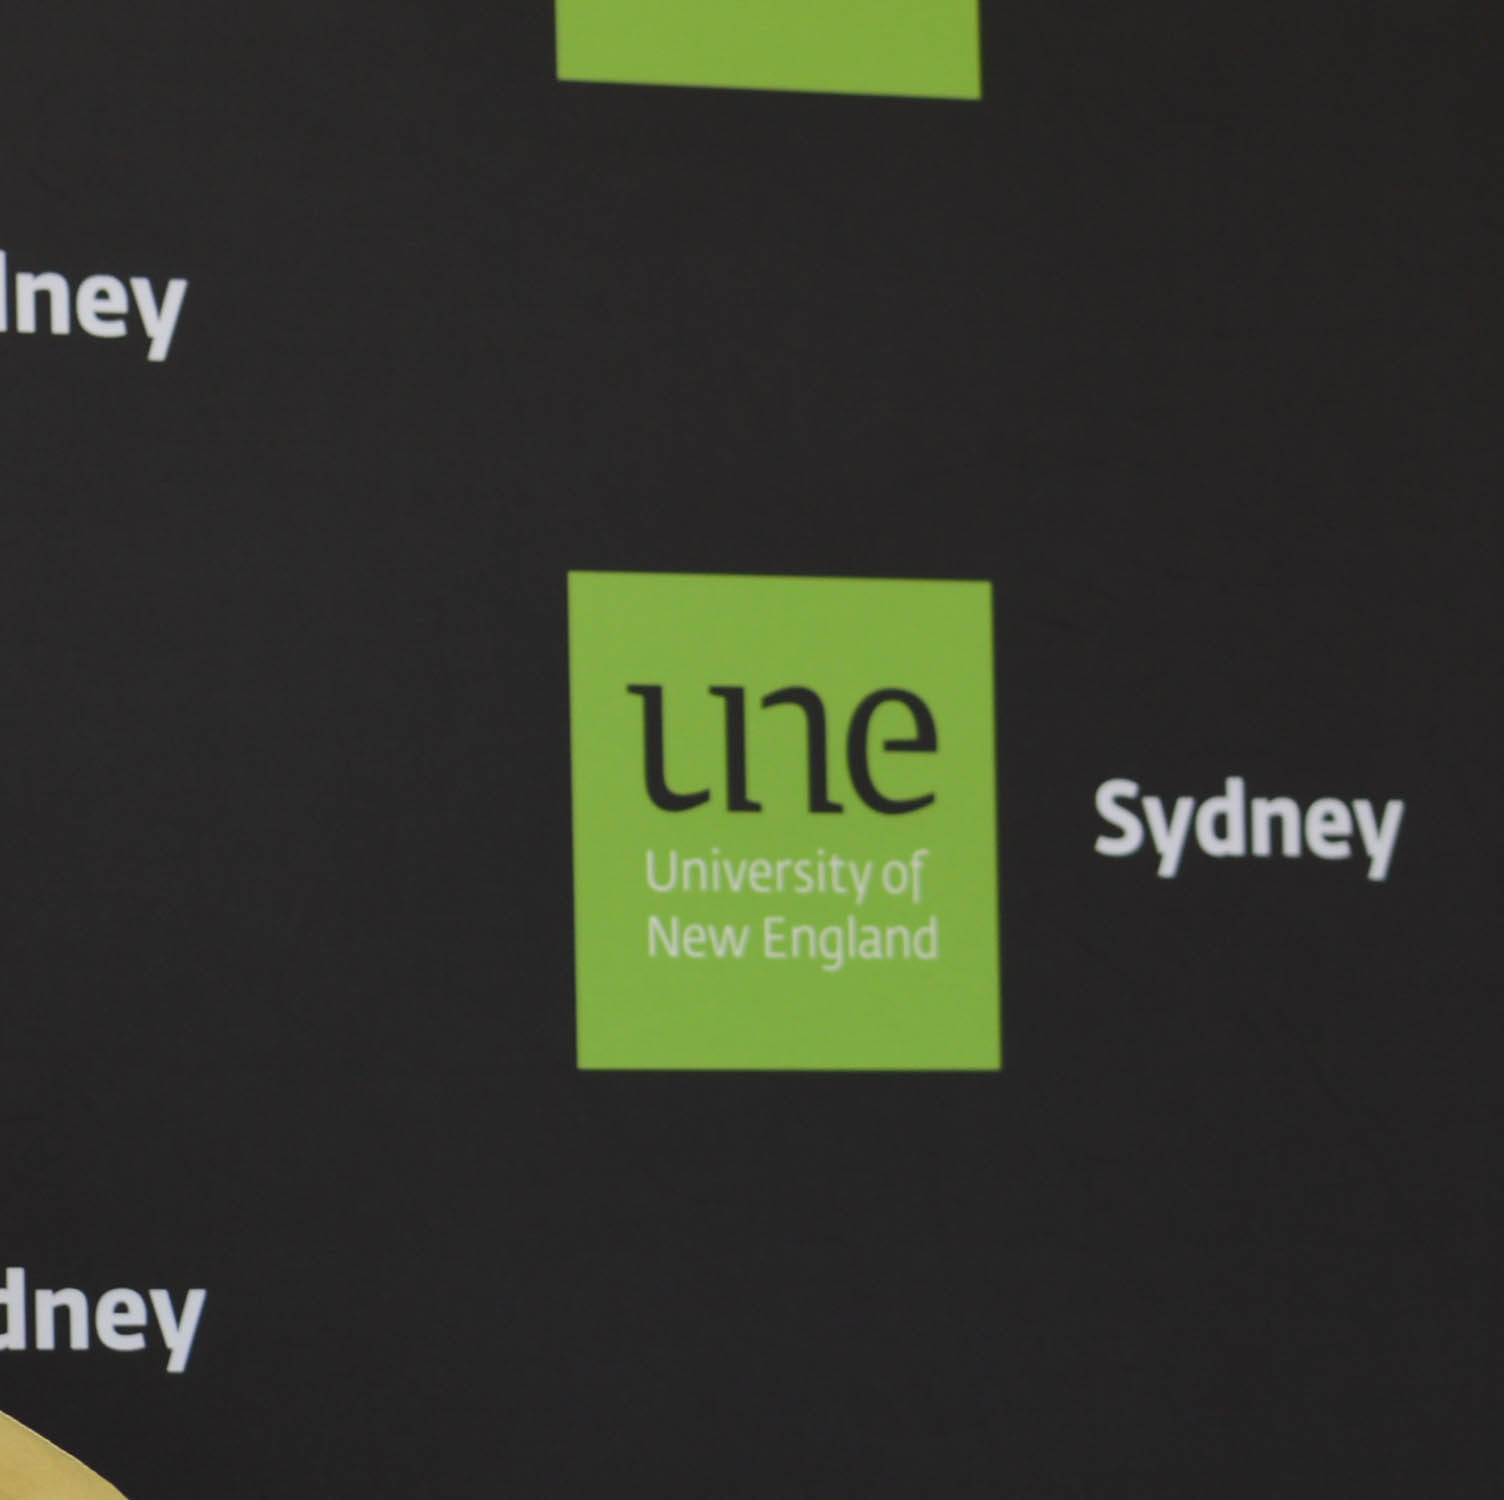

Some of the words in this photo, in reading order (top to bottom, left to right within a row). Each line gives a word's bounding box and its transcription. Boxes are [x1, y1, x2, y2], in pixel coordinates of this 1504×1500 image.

[626, 683, 938, 816] une
[1095, 776, 1403, 880] Sydney
[645, 847, 875, 905] University
[881, 848, 930, 905] of
[648, 914, 750, 959] New
[763, 914, 941, 973] England
